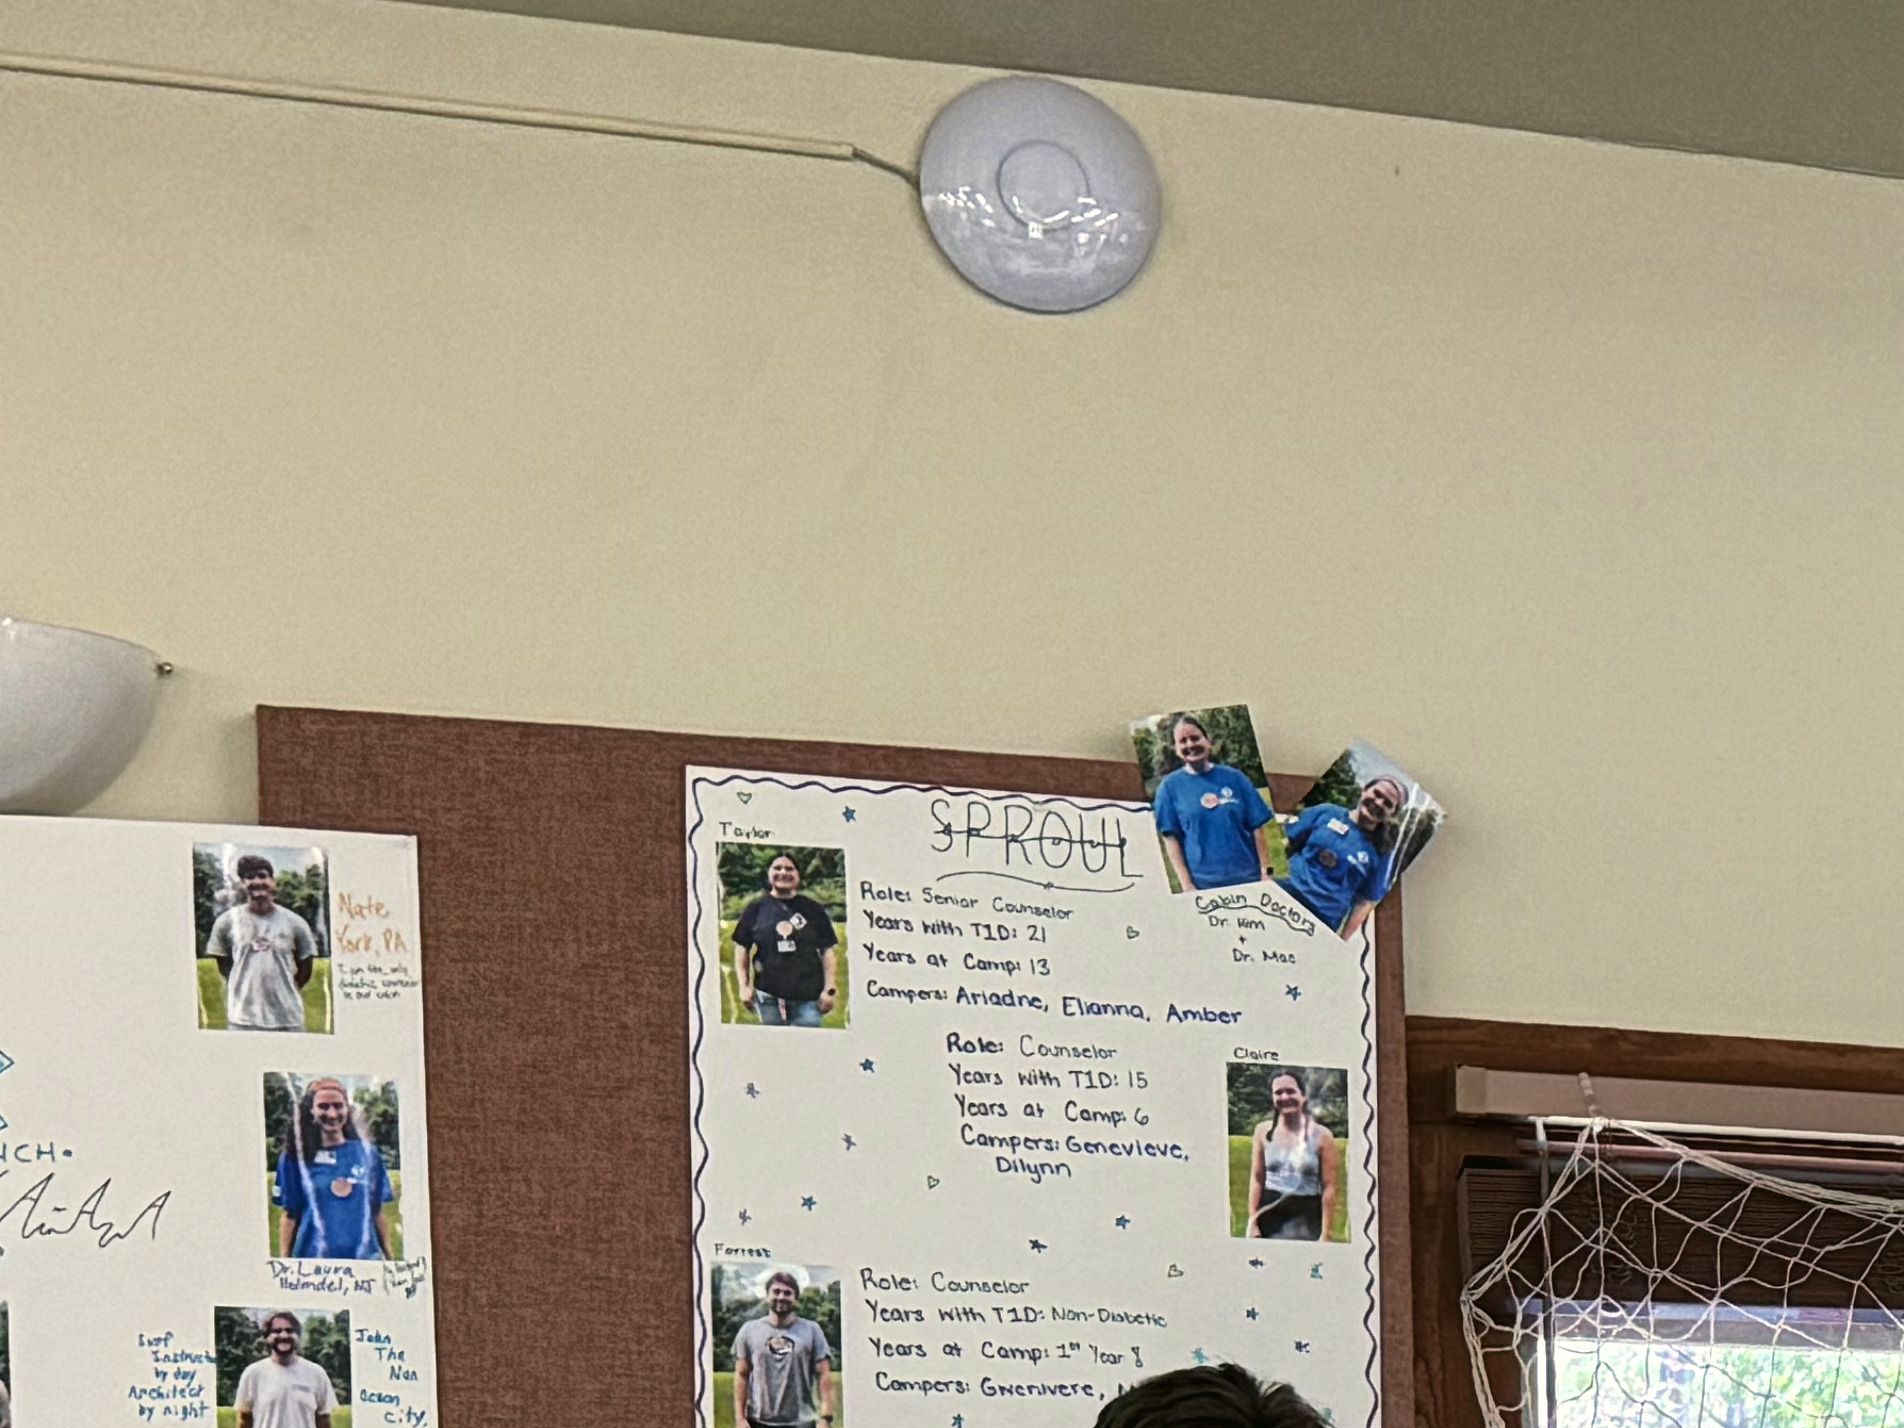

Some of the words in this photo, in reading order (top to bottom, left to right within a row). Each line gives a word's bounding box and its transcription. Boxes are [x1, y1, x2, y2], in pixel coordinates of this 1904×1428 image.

[931, 799, 1144, 878] SPROUL
[860, 880, 912, 903] Role:
[922, 887, 979, 909] Senior
[992, 896, 1074, 921] Counselor
[1196, 893, 1249, 911] Cabin
[863, 908, 914, 932] Years
[922, 920, 963, 937] with
[970, 922, 1018, 943] T1D:
[1026, 924, 1048, 943] 21
[383, 927, 407, 952] PA
[862, 942, 917, 965] Years
[926, 951, 949, 968] at
[963, 952, 1021, 977] Camp:
[1030, 957, 1052, 976] 13
[1231, 948, 1255, 963] Dr.
[866, 979, 949, 1005] Campers:
[955, 985, 1050, 1013] Ariadne,
[1166, 1003, 1243, 1024] Amber
[946, 1031, 1005, 1055] Role:
[1019, 1033, 1118, 1060] Counselor
[1233, 1046, 1280, 1061] Claire
[948, 1062, 1004, 1086] Years
[1018, 1068, 1062, 1088] with
[1068, 1069, 1119, 1090] T1D:
[1127, 1069, 1150, 1090] 15
[953, 1092, 1009, 1119] Years
[1022, 1101, 1045, 1119] at
[1064, 1100, 1127, 1127] Camp:
[1133, 1106, 1150, 1126] 6
[960, 1122, 1060, 1153] Campers:
[1065, 1134, 1189, 1162] Genevieve,
[995, 1156, 1073, 1185] Dilynn
[713, 1242, 772, 1258] Forrest
[267, 1260, 295, 1279] Dr.
[298, 1261, 354, 1278] Laura
[860, 1267, 918, 1292] Role:
[931, 1271, 1030, 1294] Counselor
[353, 1278, 377, 1295] NJ
[865, 1298, 926, 1323] Years
[938, 1304, 986, 1324] with
[1051, 1305, 1168, 1329] Non-Diabetic
[354, 1328, 392, 1345] John
[868, 1336, 928, 1358] Years
[942, 1340, 963, 1357] at
[981, 1340, 1050, 1366] Camp:
[128, 1385, 206, 1401] Architect
[876, 1370, 970, 1395] Campers:
[139, 1404, 154, 1421] by
[163, 1403, 210, 1421] night
